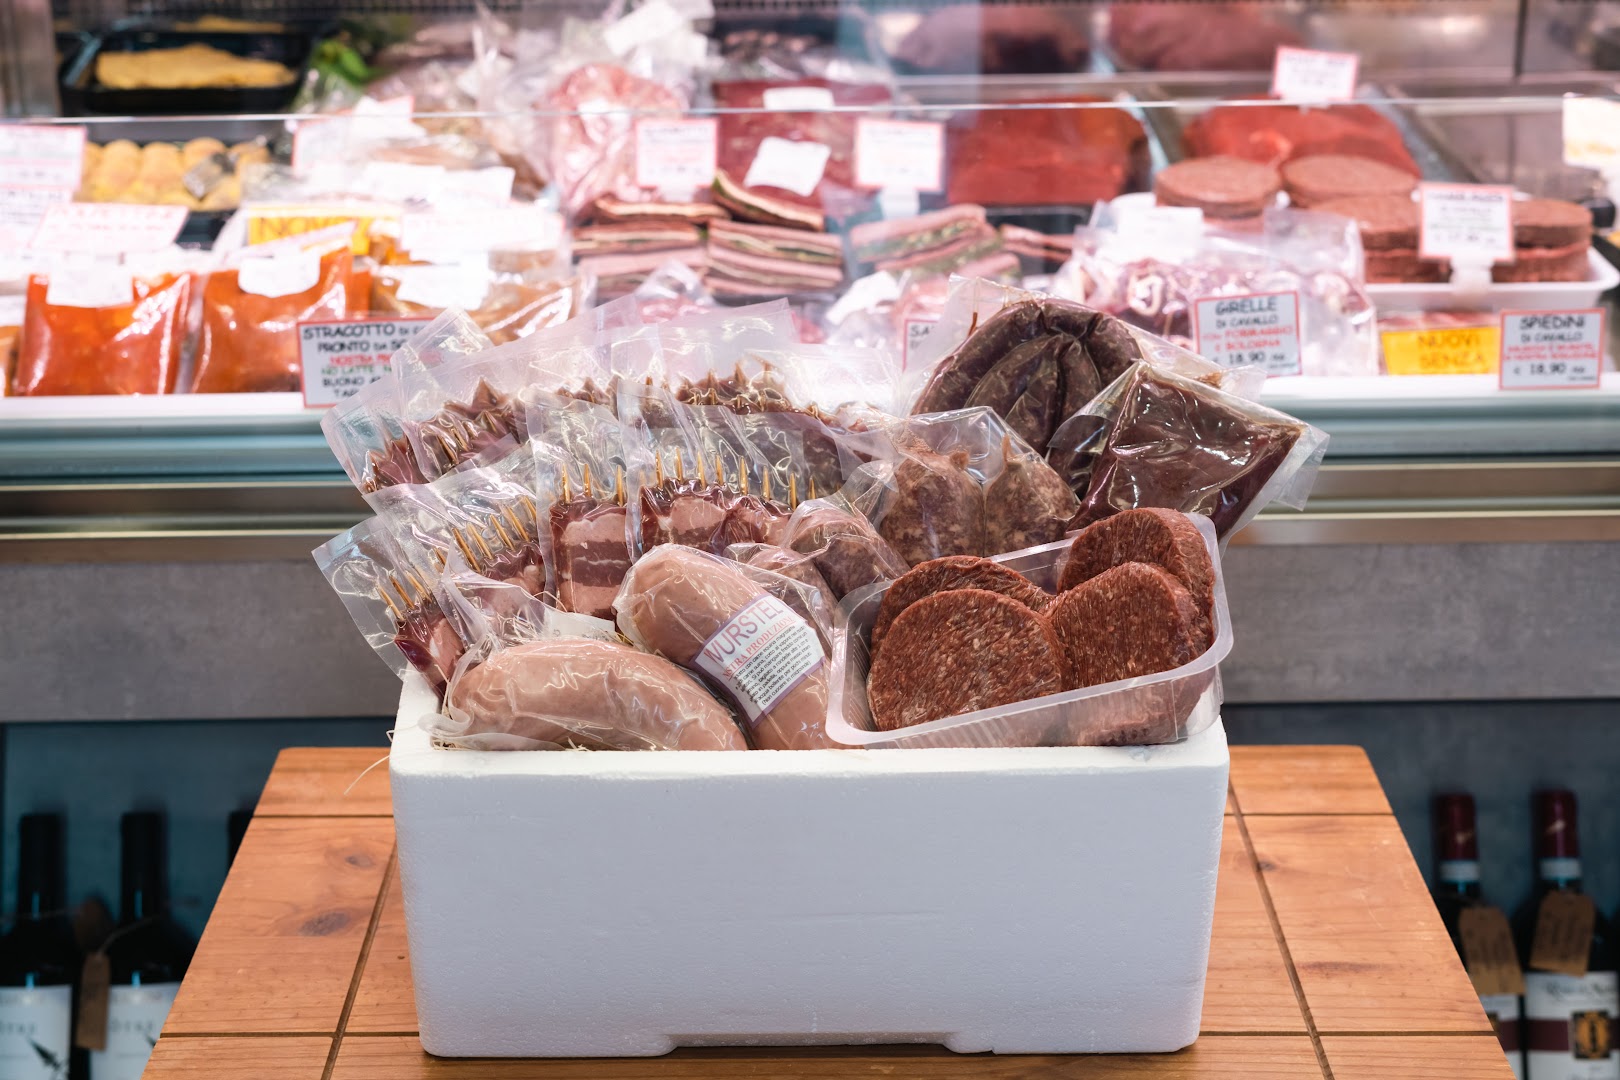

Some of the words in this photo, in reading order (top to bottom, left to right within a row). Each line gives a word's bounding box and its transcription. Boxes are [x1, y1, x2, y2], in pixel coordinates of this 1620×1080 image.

[303, 323, 396, 340] STRACOTTO
[318, 341, 371, 353] PRONTO
[323, 377, 365, 388] BUONO
[703, 600, 784, 664] WURSTEL
